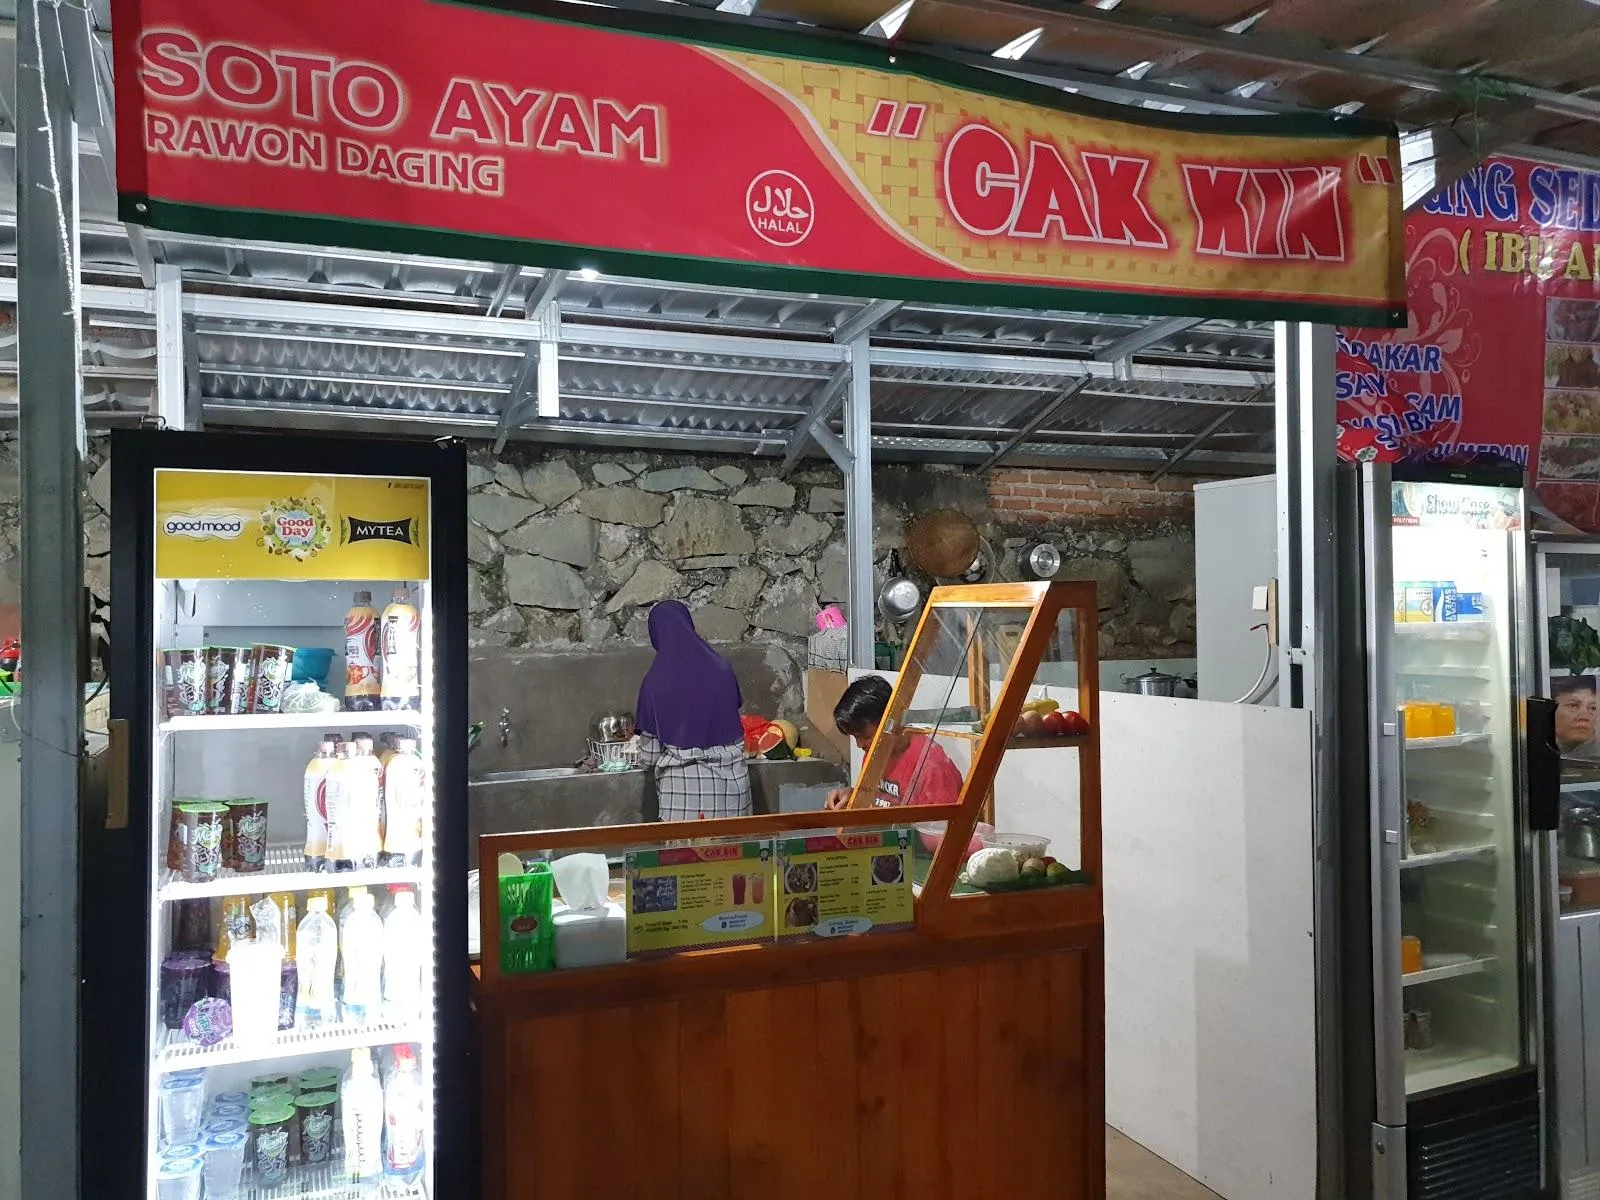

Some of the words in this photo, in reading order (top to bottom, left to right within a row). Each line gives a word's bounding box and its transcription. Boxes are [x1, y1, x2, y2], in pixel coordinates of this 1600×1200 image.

[139, 28, 402, 133] SOTO
[430, 76, 664, 164] AYAM
[146, 113, 326, 171] RAWON
[337, 137, 505, 196] DAGING
[753, 185, 809, 219] حلال
[757, 217, 804, 235] HALAL
[277, 516, 314, 528] Good
[356, 525, 404, 537] MYTEA
[281, 526, 312, 538] Day
